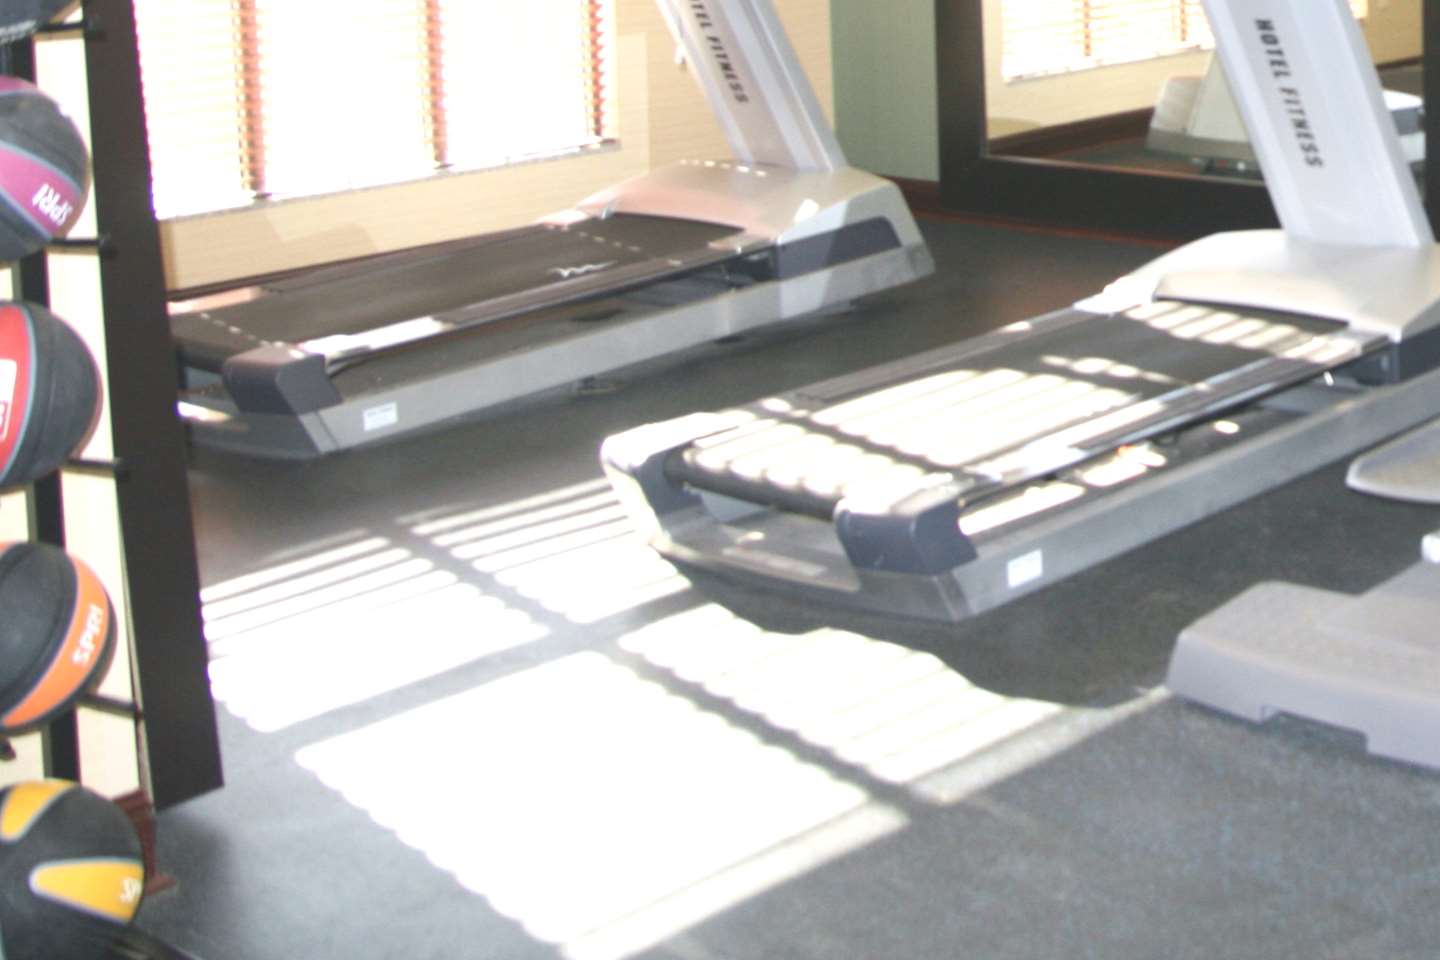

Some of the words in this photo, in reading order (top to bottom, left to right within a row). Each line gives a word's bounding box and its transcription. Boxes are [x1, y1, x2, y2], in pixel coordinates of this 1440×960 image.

[706, 36, 750, 103] FITNESS
[1255, 19, 1291, 78] HOTEL
[1279, 87, 1323, 168] FITNESS
[32, 183, 73, 226] SPRI
[72, 604, 104, 666] SPRI
